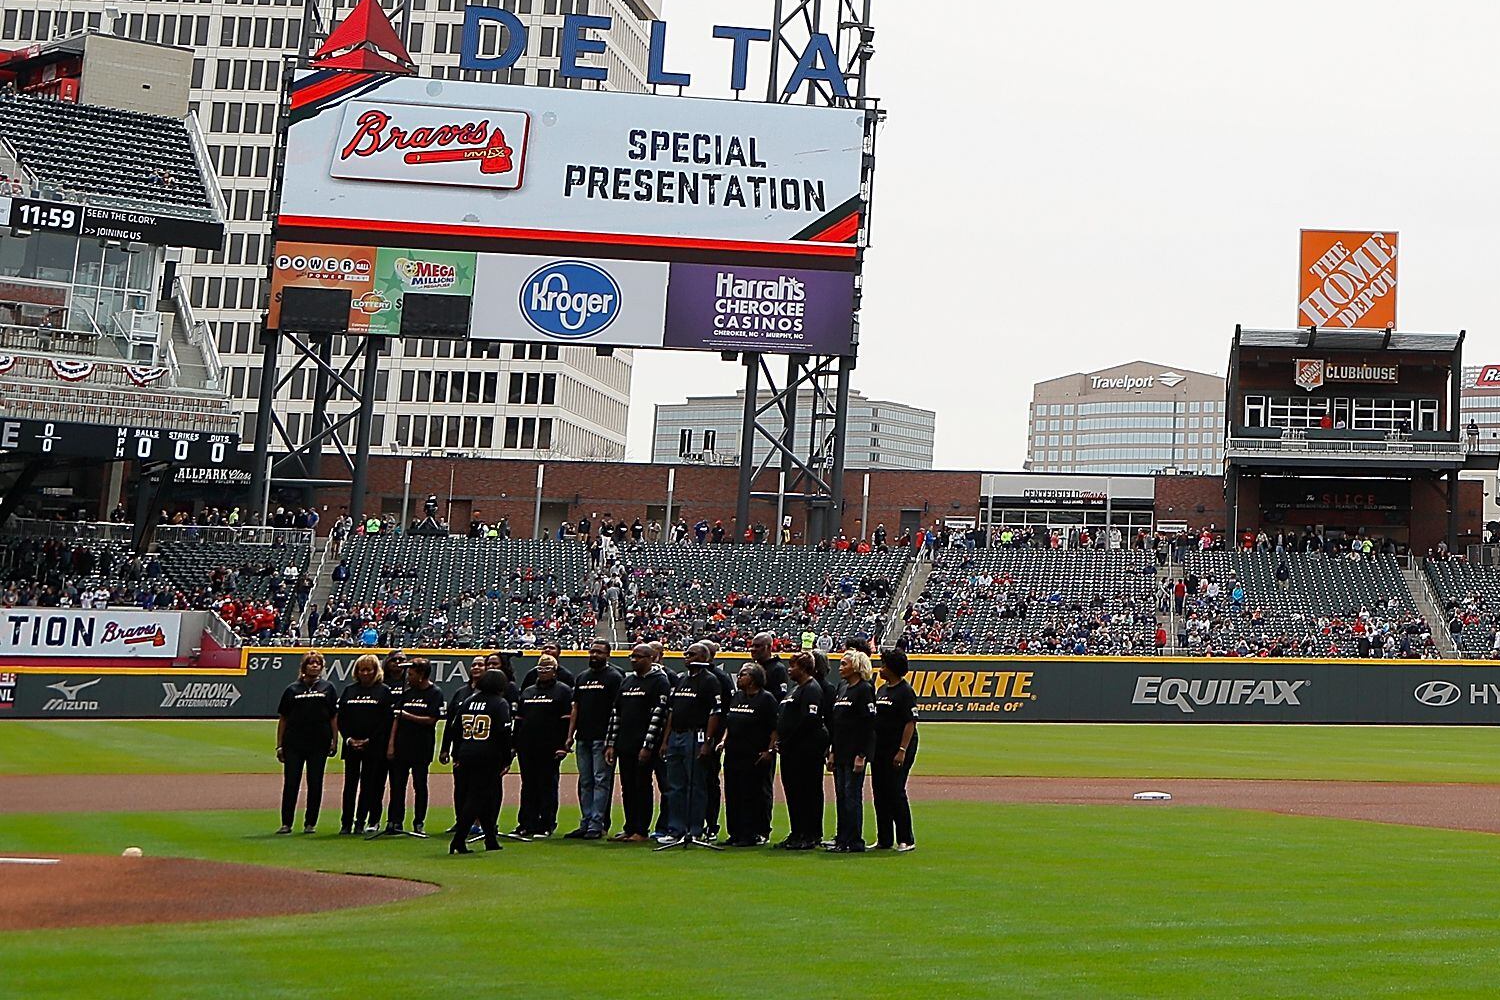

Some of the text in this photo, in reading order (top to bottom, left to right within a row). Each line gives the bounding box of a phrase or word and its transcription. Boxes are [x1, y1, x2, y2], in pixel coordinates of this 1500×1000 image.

[459, 3, 851, 99] DELTA
[341, 109, 490, 160] Braves
[628, 129, 767, 169] SPECIAL
[563, 164, 826, 212] PRESENTATION
[19, 205, 75, 229] 11:59
[87, 209, 109, 220] SEEN
[110, 211, 127, 222] THE
[96, 227, 129, 239] JOINING
[129, 231, 142, 241] US
[278, 257, 353, 271] POWER
[1308, 240, 1350, 280] THE
[416, 262, 454, 277] MEGA
[411, 277, 454, 285] MILLIONS
[1299, 231, 1398, 328] HOME
[353, 300, 390, 309] LOTTERY
[530, 273, 614, 329] Kroger
[1336, 267, 1397, 329] DEPOT
[715, 298, 805, 317] CHEROKEE
[714, 315, 803, 332] CASINOS
[713, 329, 748, 338] CHEROKEE,
[1325, 366, 1396, 380] CLUBHOUSE
[1090, 375, 1154, 391] Travelport
[44, 423, 55, 436] 0
[134, 429, 160, 438] BALLS
[168, 431, 200, 441] STRIKES
[42, 438, 53, 452] 0
[210, 434, 230, 442] OUTS
[137, 437, 152, 458] 0
[174, 440, 189, 460] 0
[210, 442, 225, 463] 0
[175, 467, 228, 480] ALLPARK
[1023, 488, 1080, 498] CENTERFIELD
[1322, 494, 1376, 505] SLICE
[8, 615, 157, 648] TION Braves
[249, 656, 283, 671] 375
[180, 683, 232, 699] ARROW
[1131, 676, 1303, 713] EQUIFAX
[42, 698, 98, 711] MIZUNO
[176, 698, 230, 708] EXTERMINATORS
[916, 701, 1020, 713] merica's Made Of
[461, 714, 491, 740] 50
